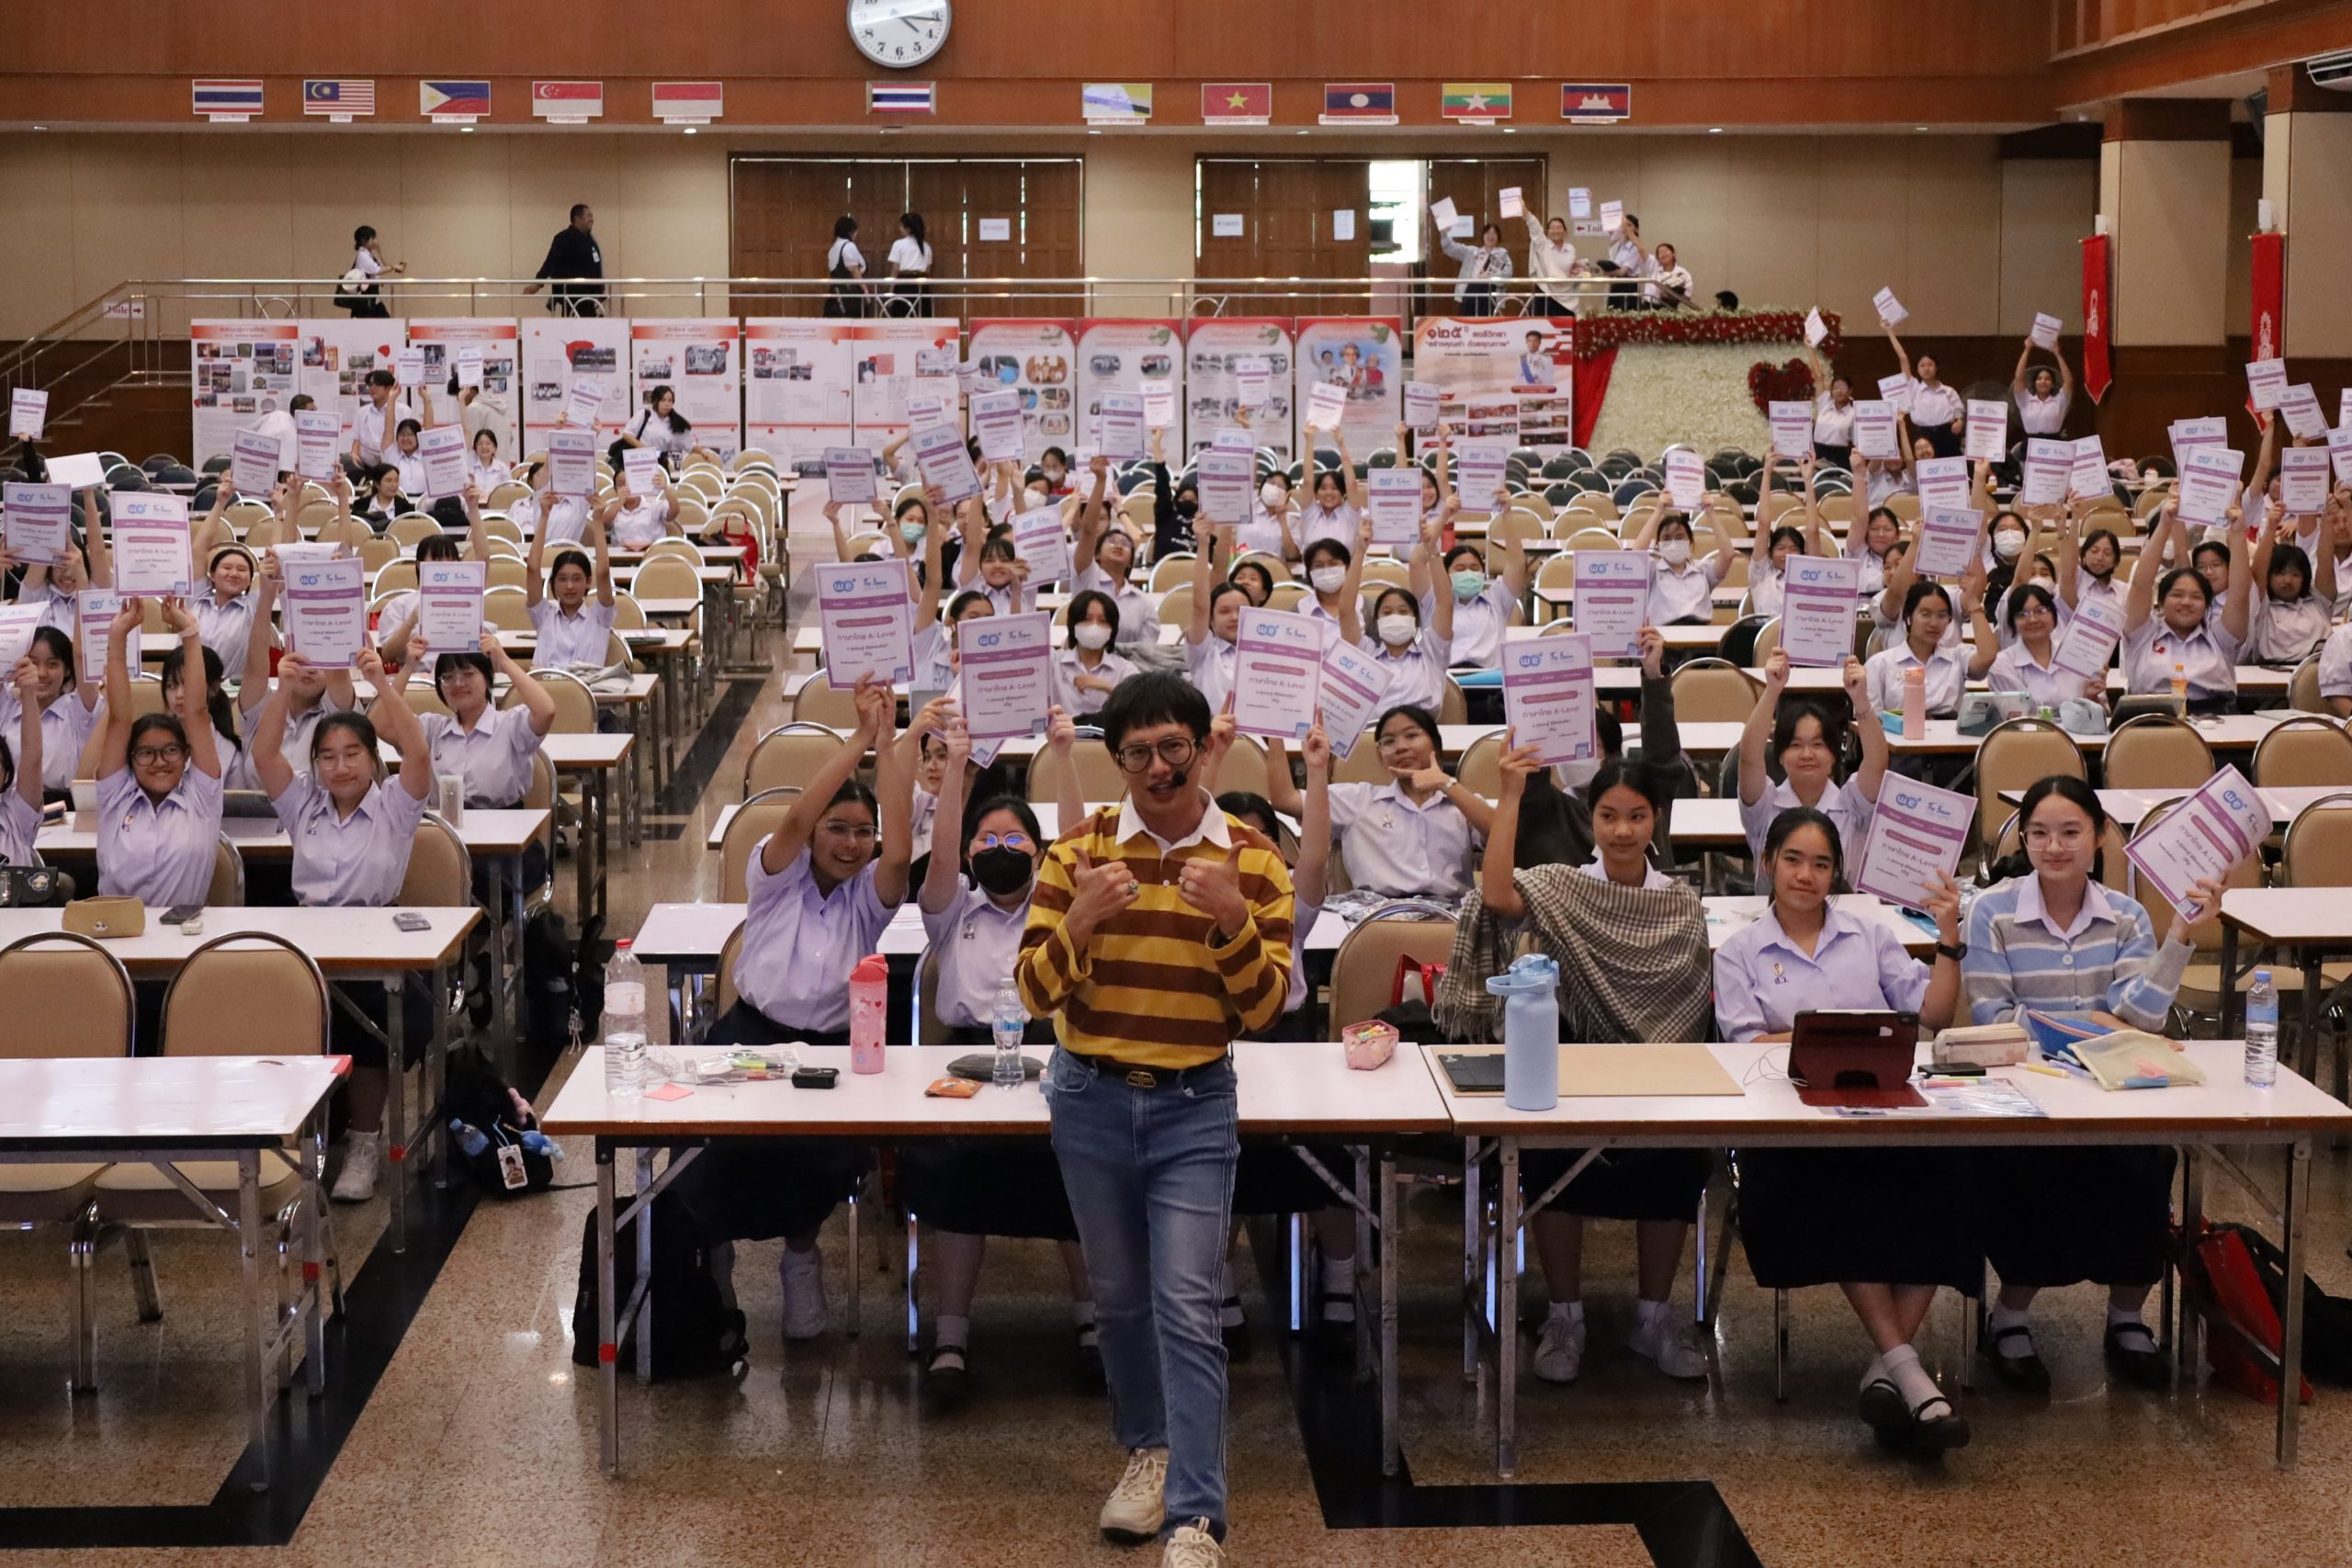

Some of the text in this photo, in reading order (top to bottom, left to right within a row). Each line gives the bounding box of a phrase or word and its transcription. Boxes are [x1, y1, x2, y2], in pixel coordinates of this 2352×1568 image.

[865, 28, 874, 39] 8
[926, 28, 933, 39] 4
[878, 41, 886, 51] 7
[896, 46, 903, 56] 6
[913, 41, 922, 51] 5
[1896, 794, 1917, 808] we
